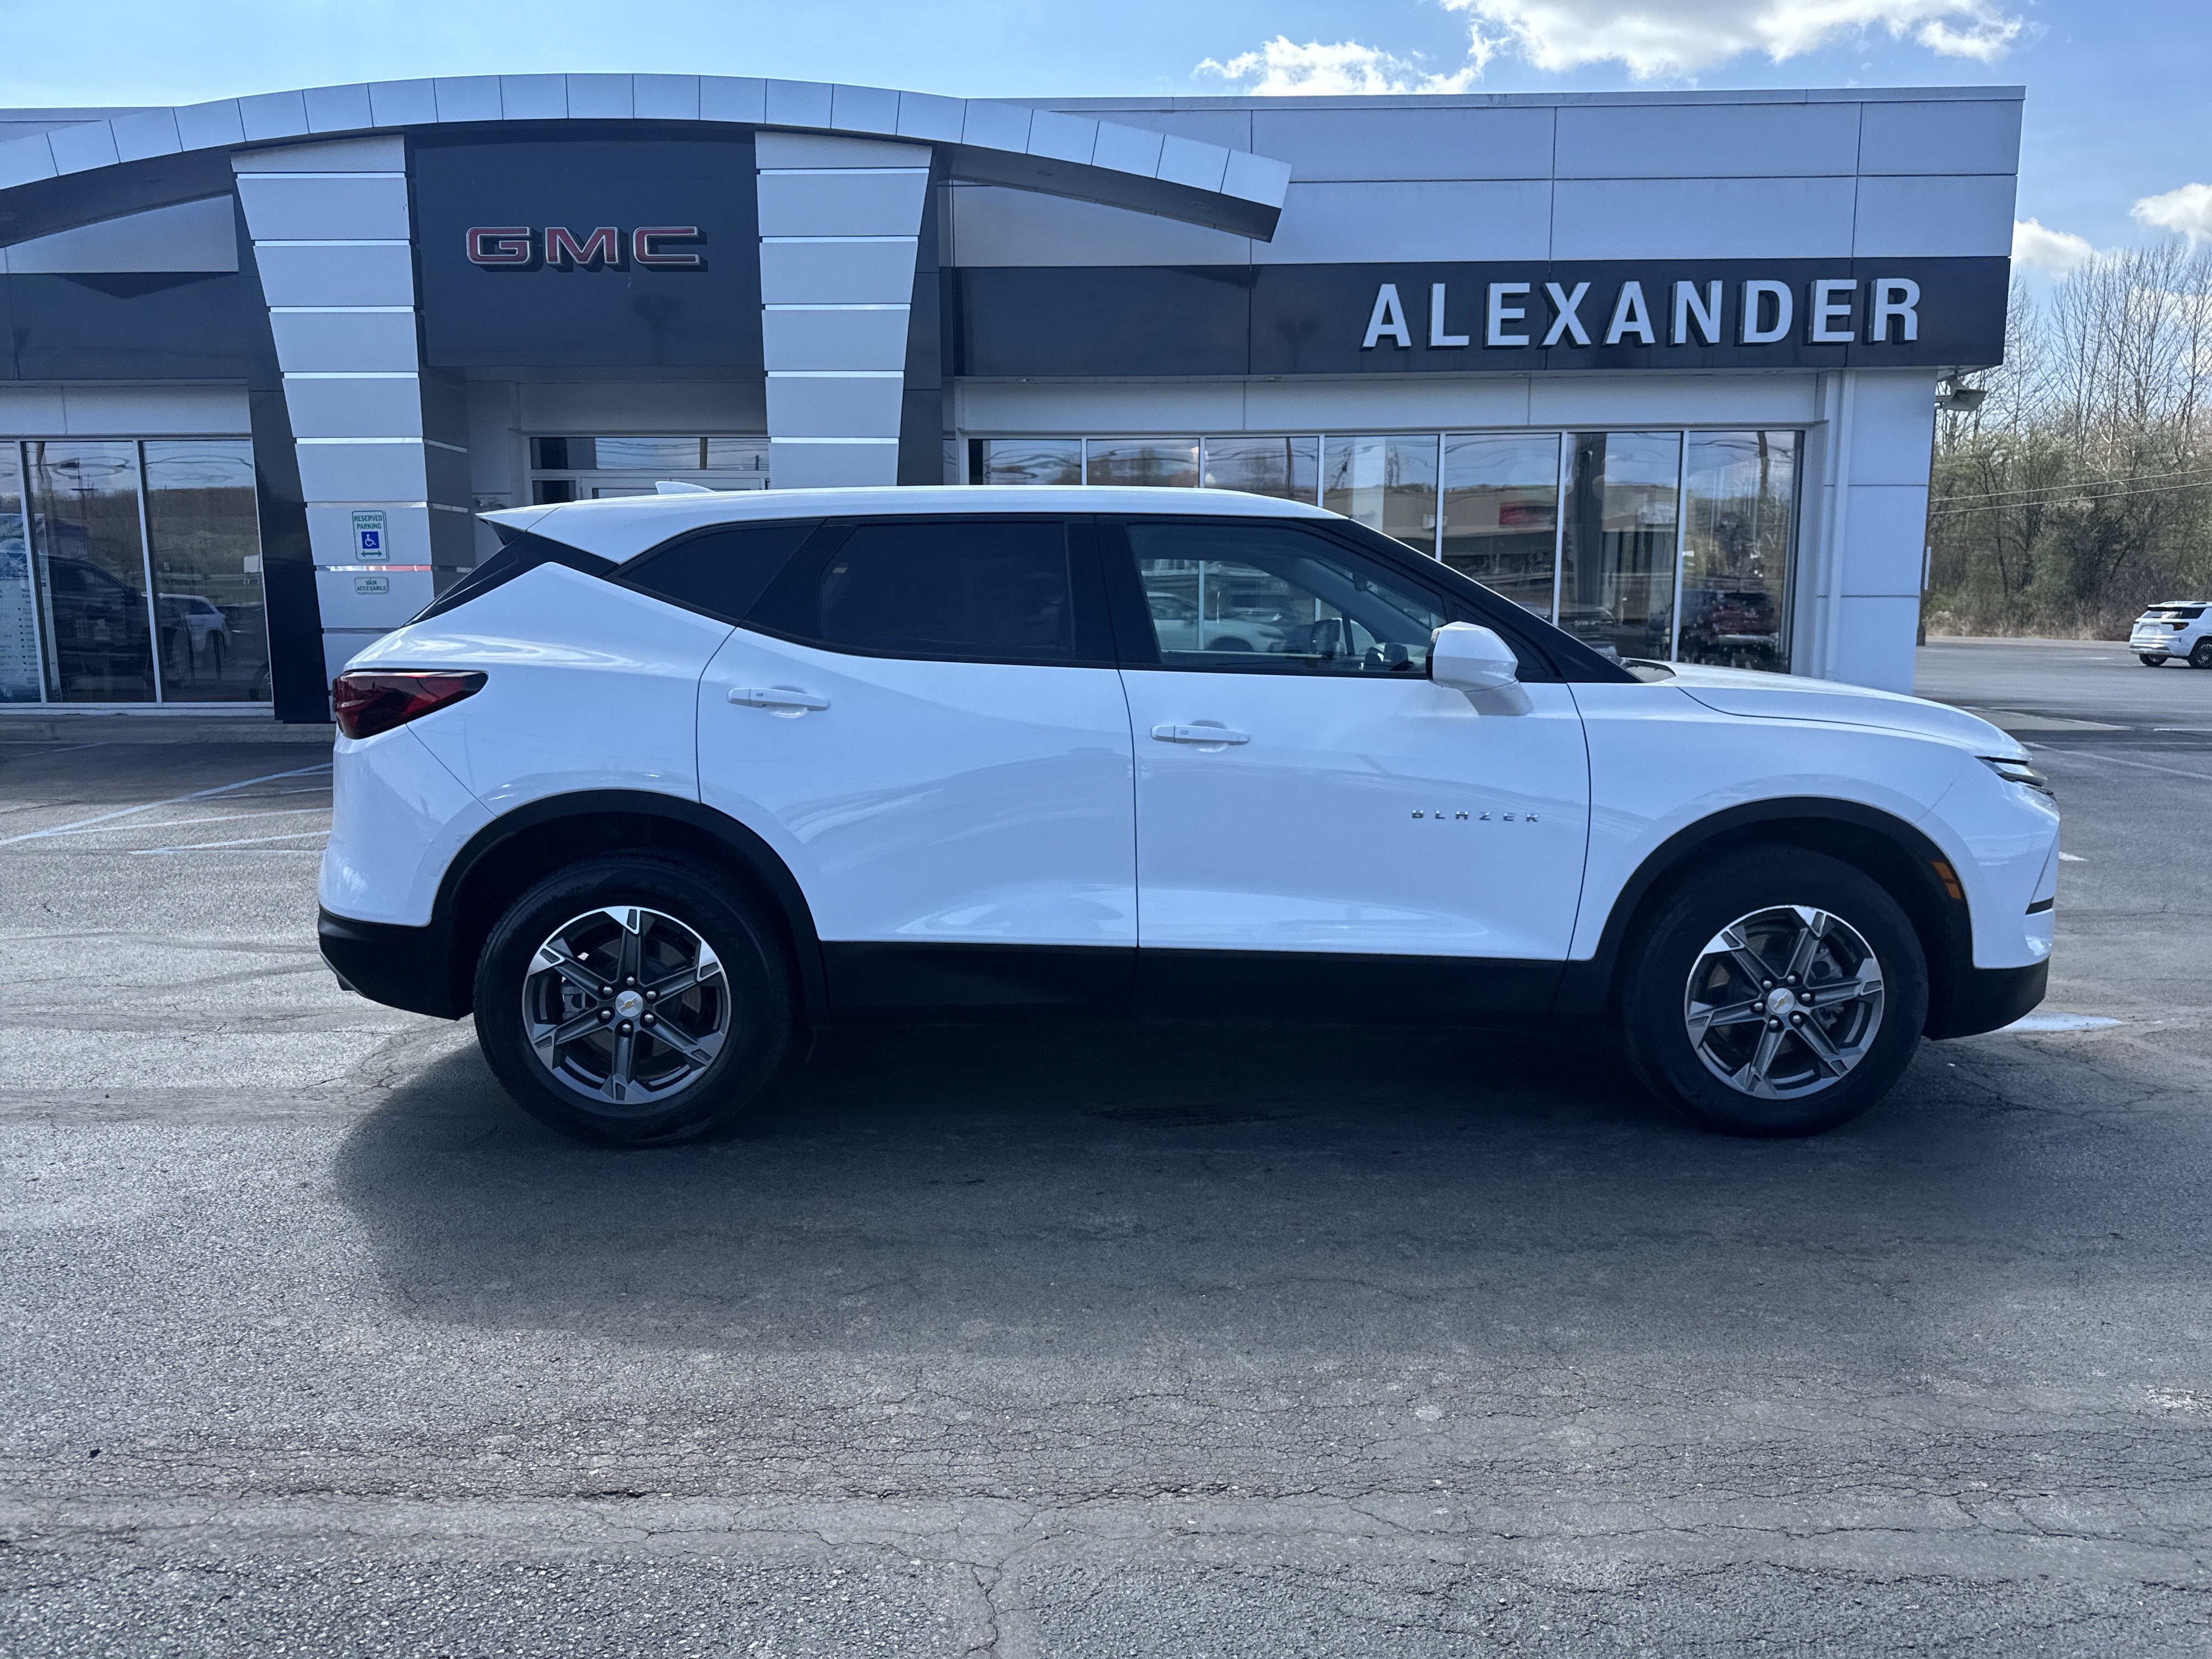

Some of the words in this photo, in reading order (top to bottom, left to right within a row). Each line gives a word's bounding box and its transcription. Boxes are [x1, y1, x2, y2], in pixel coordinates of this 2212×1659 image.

[466, 227, 701, 264] GMC
[1362, 278, 1921, 347] ALEXANDER
[1412, 810, 1538, 822] BLAZER
